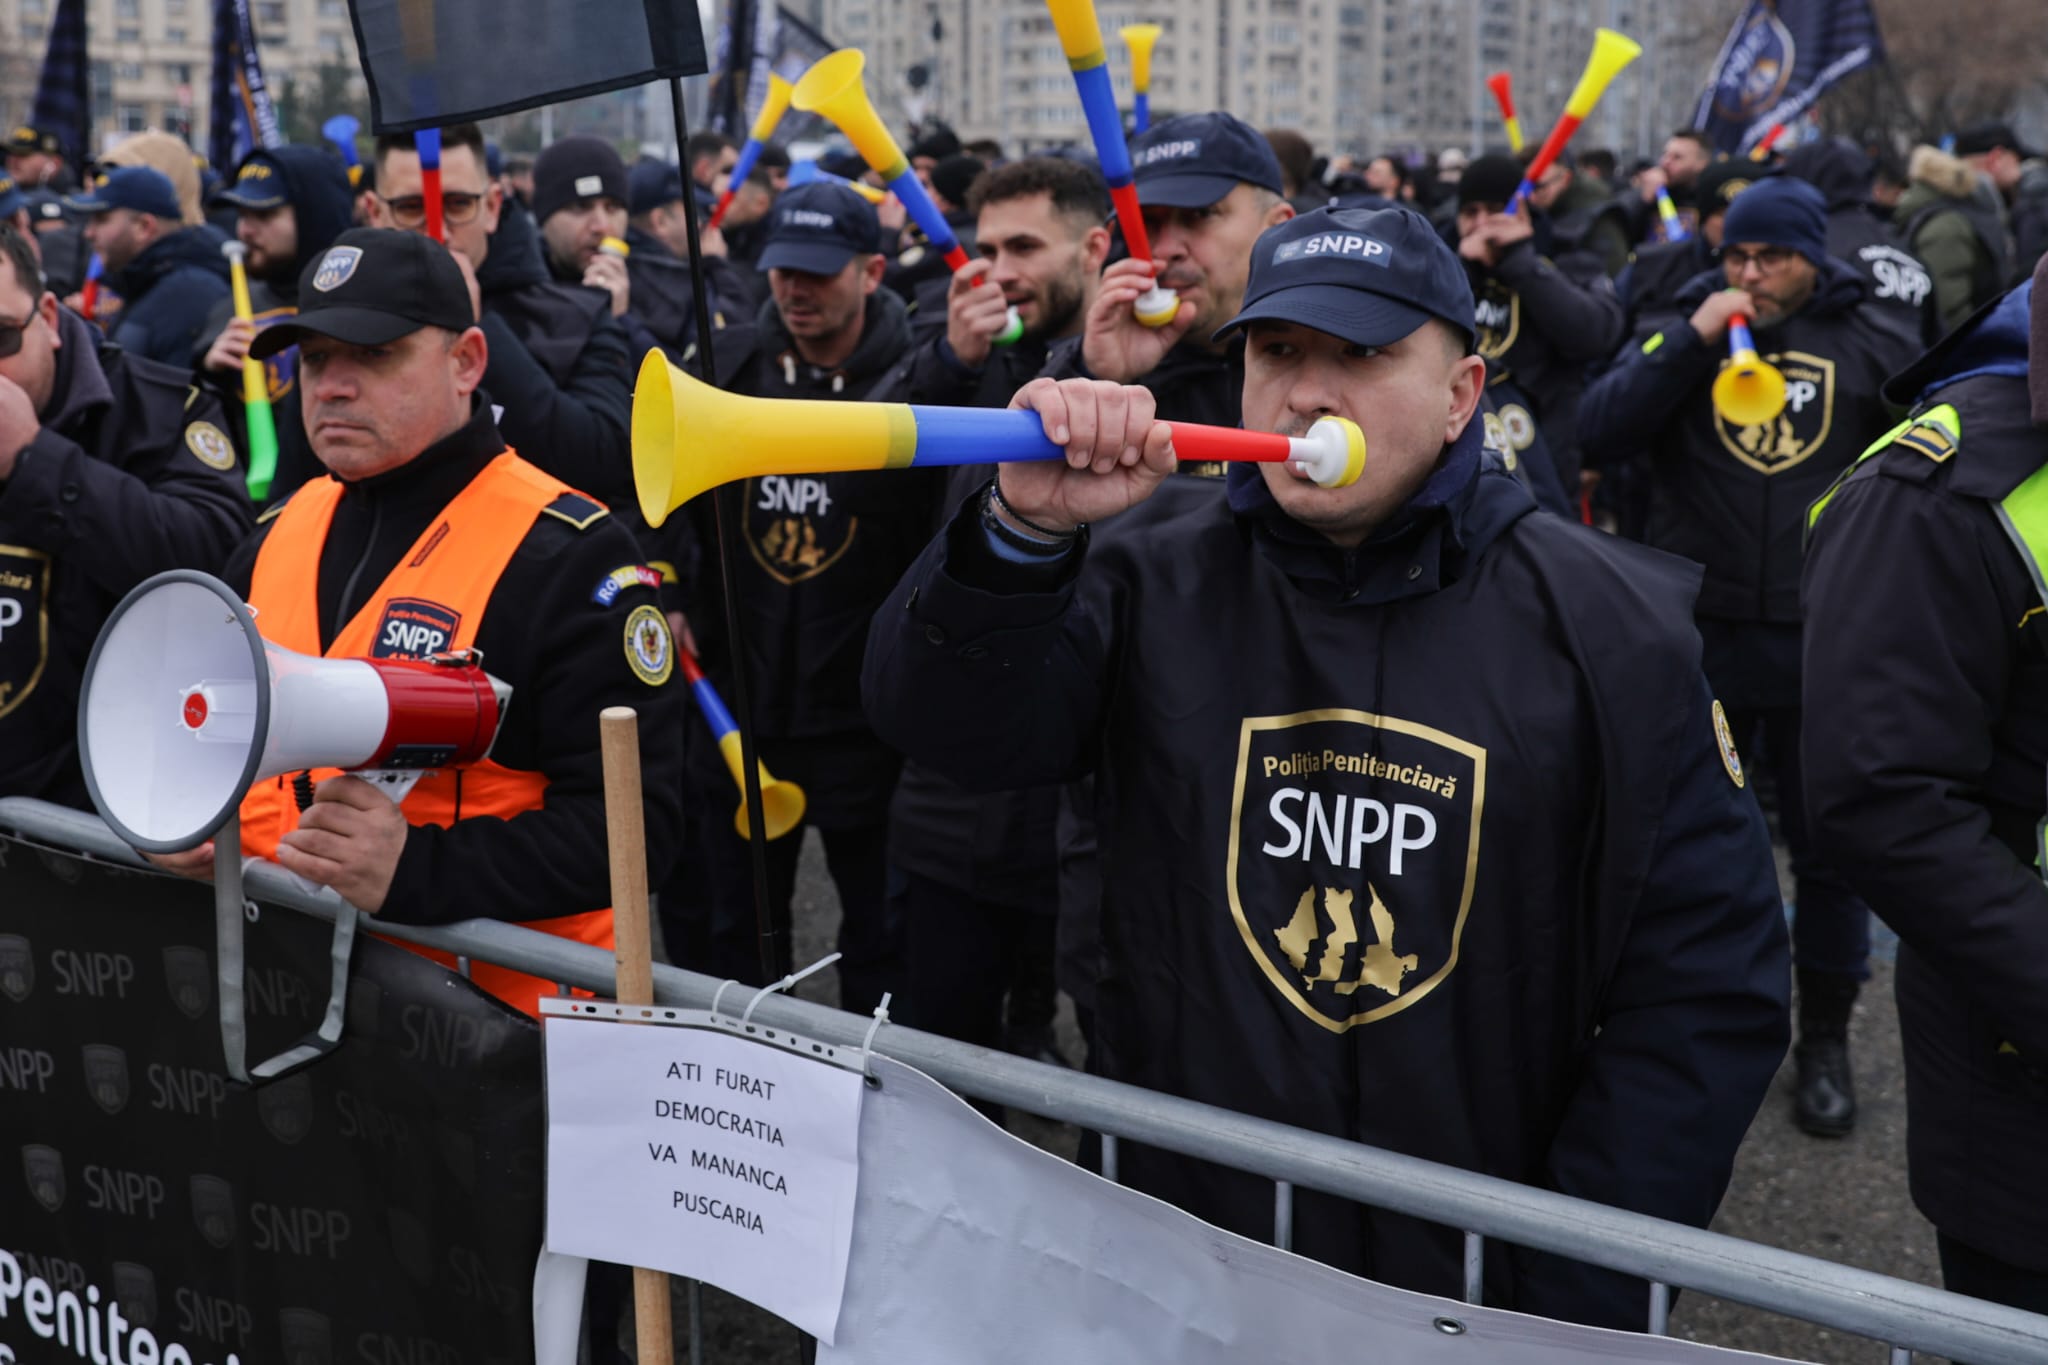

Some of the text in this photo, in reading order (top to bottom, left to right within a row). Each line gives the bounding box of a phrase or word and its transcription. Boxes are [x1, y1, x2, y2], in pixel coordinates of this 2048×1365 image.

[1304, 235, 1383, 257] SNPP
[382, 620, 444, 655] SNPP
[1263, 750, 1457, 799] Poliția Penitenciară
[1262, 787, 1437, 875] SNPP
[51, 949, 134, 999] SNPP
[247, 967, 310, 1020] NPP
[0, 1047, 55, 1094] NPP
[147, 1063, 226, 1119] SNPP
[666, 1061, 776, 1101] ATI FURAT
[655, 1099, 784, 1148] DEMOCRATIA
[83, 1164, 164, 1219] SNPP
[648, 1142, 787, 1196] VA MANANCA
[249, 1201, 351, 1260] SNPP
[673, 1190, 764, 1235] PUSCARIA
[175, 1287, 252, 1349] SNPP
